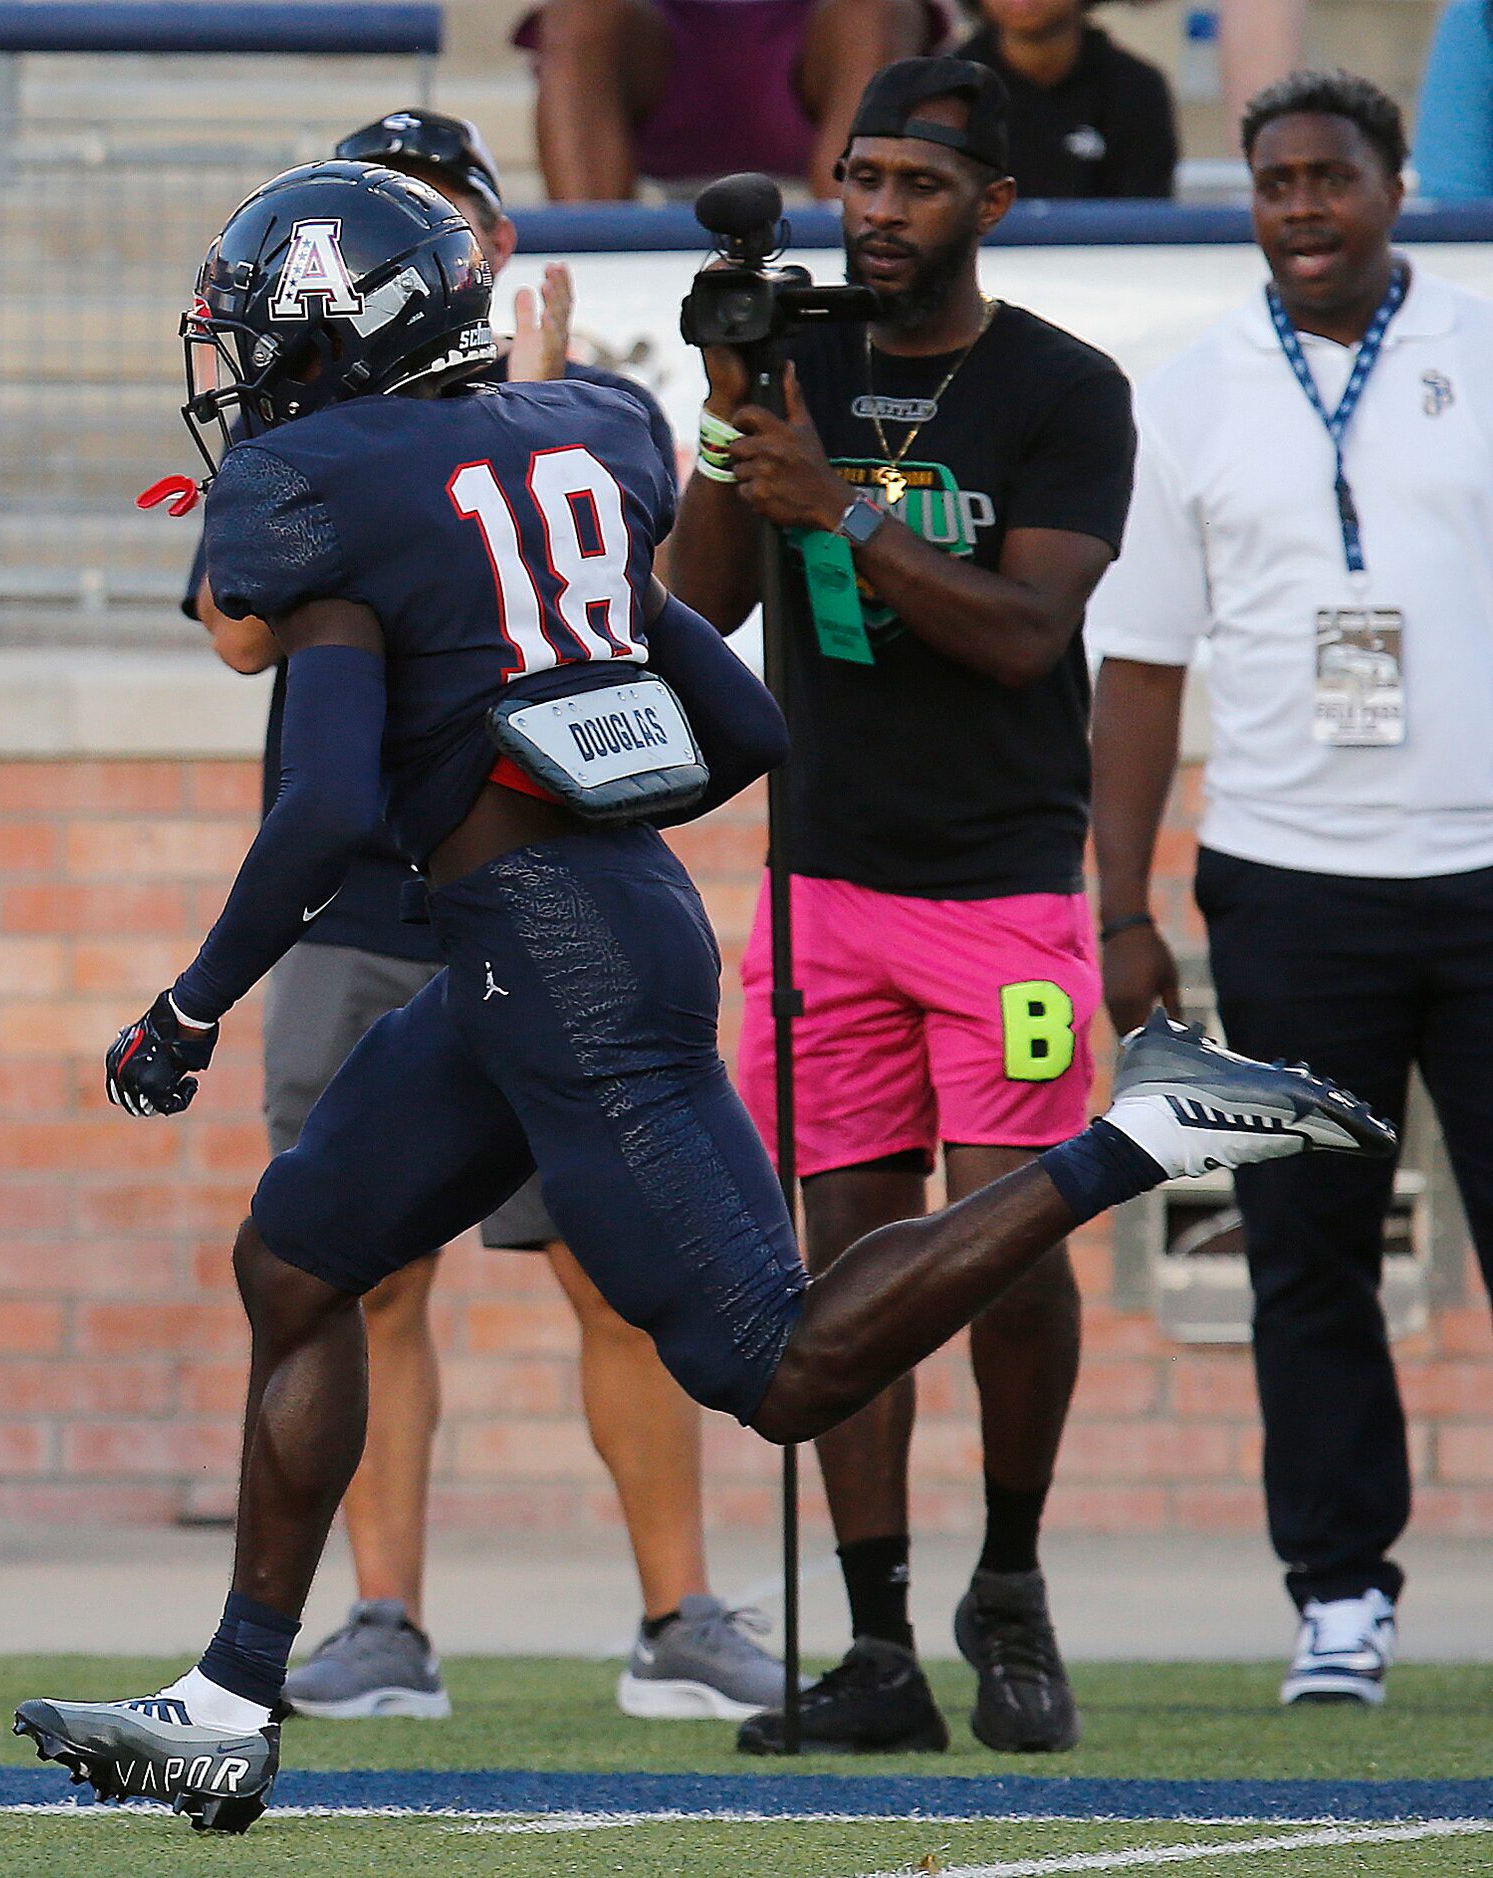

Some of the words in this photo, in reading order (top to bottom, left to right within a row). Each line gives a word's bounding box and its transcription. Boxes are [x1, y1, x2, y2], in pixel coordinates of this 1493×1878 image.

[268, 217, 366, 321] A
[445, 443, 650, 685] 18
[568, 706, 669, 763] DOUGLAS
[998, 978, 1077, 1083] B
[114, 1754, 251, 1793] VAPOR
